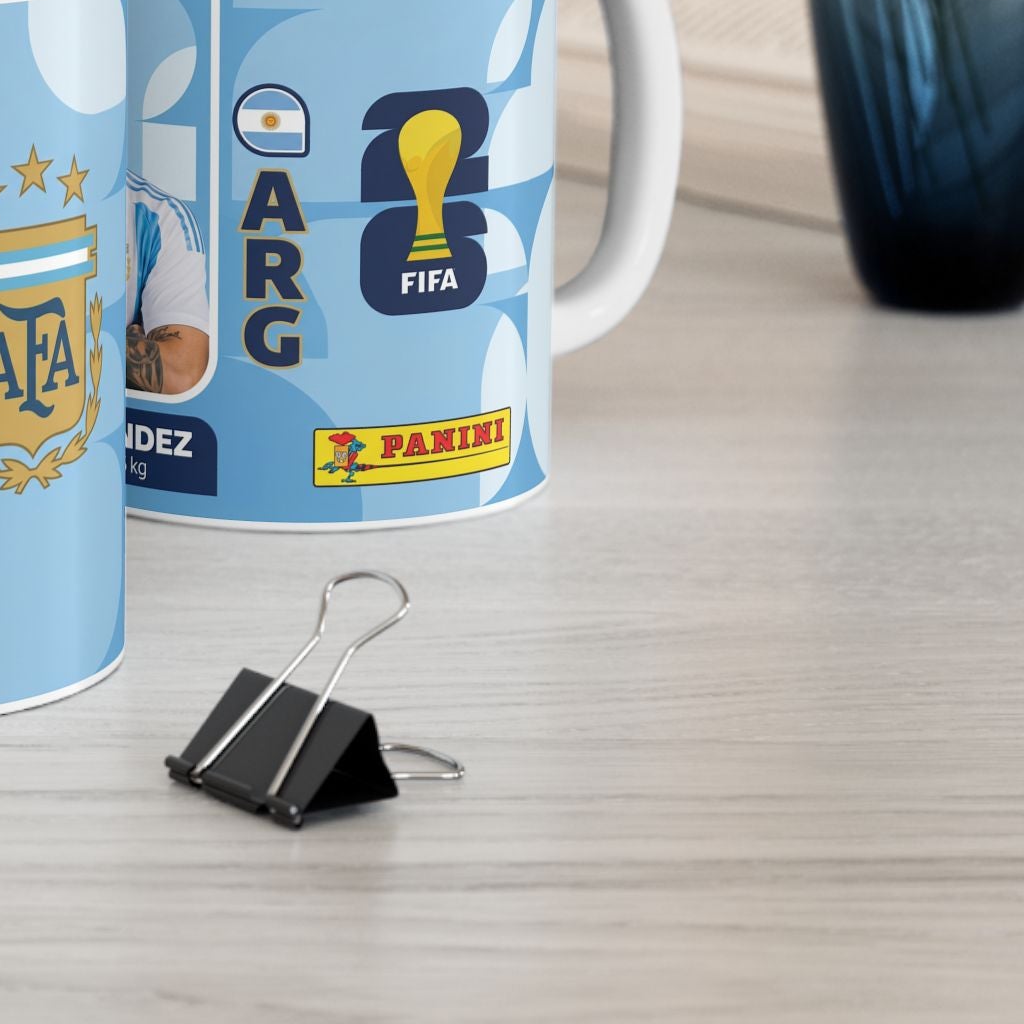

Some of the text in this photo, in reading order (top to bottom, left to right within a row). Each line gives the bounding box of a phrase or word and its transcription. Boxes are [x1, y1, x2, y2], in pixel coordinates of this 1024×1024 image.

[237, 167, 310, 370] ARG
[400, 267, 459, 295] FIFA
[380, 417, 505, 459] PANINI
[130, 456, 147, 480] kg
